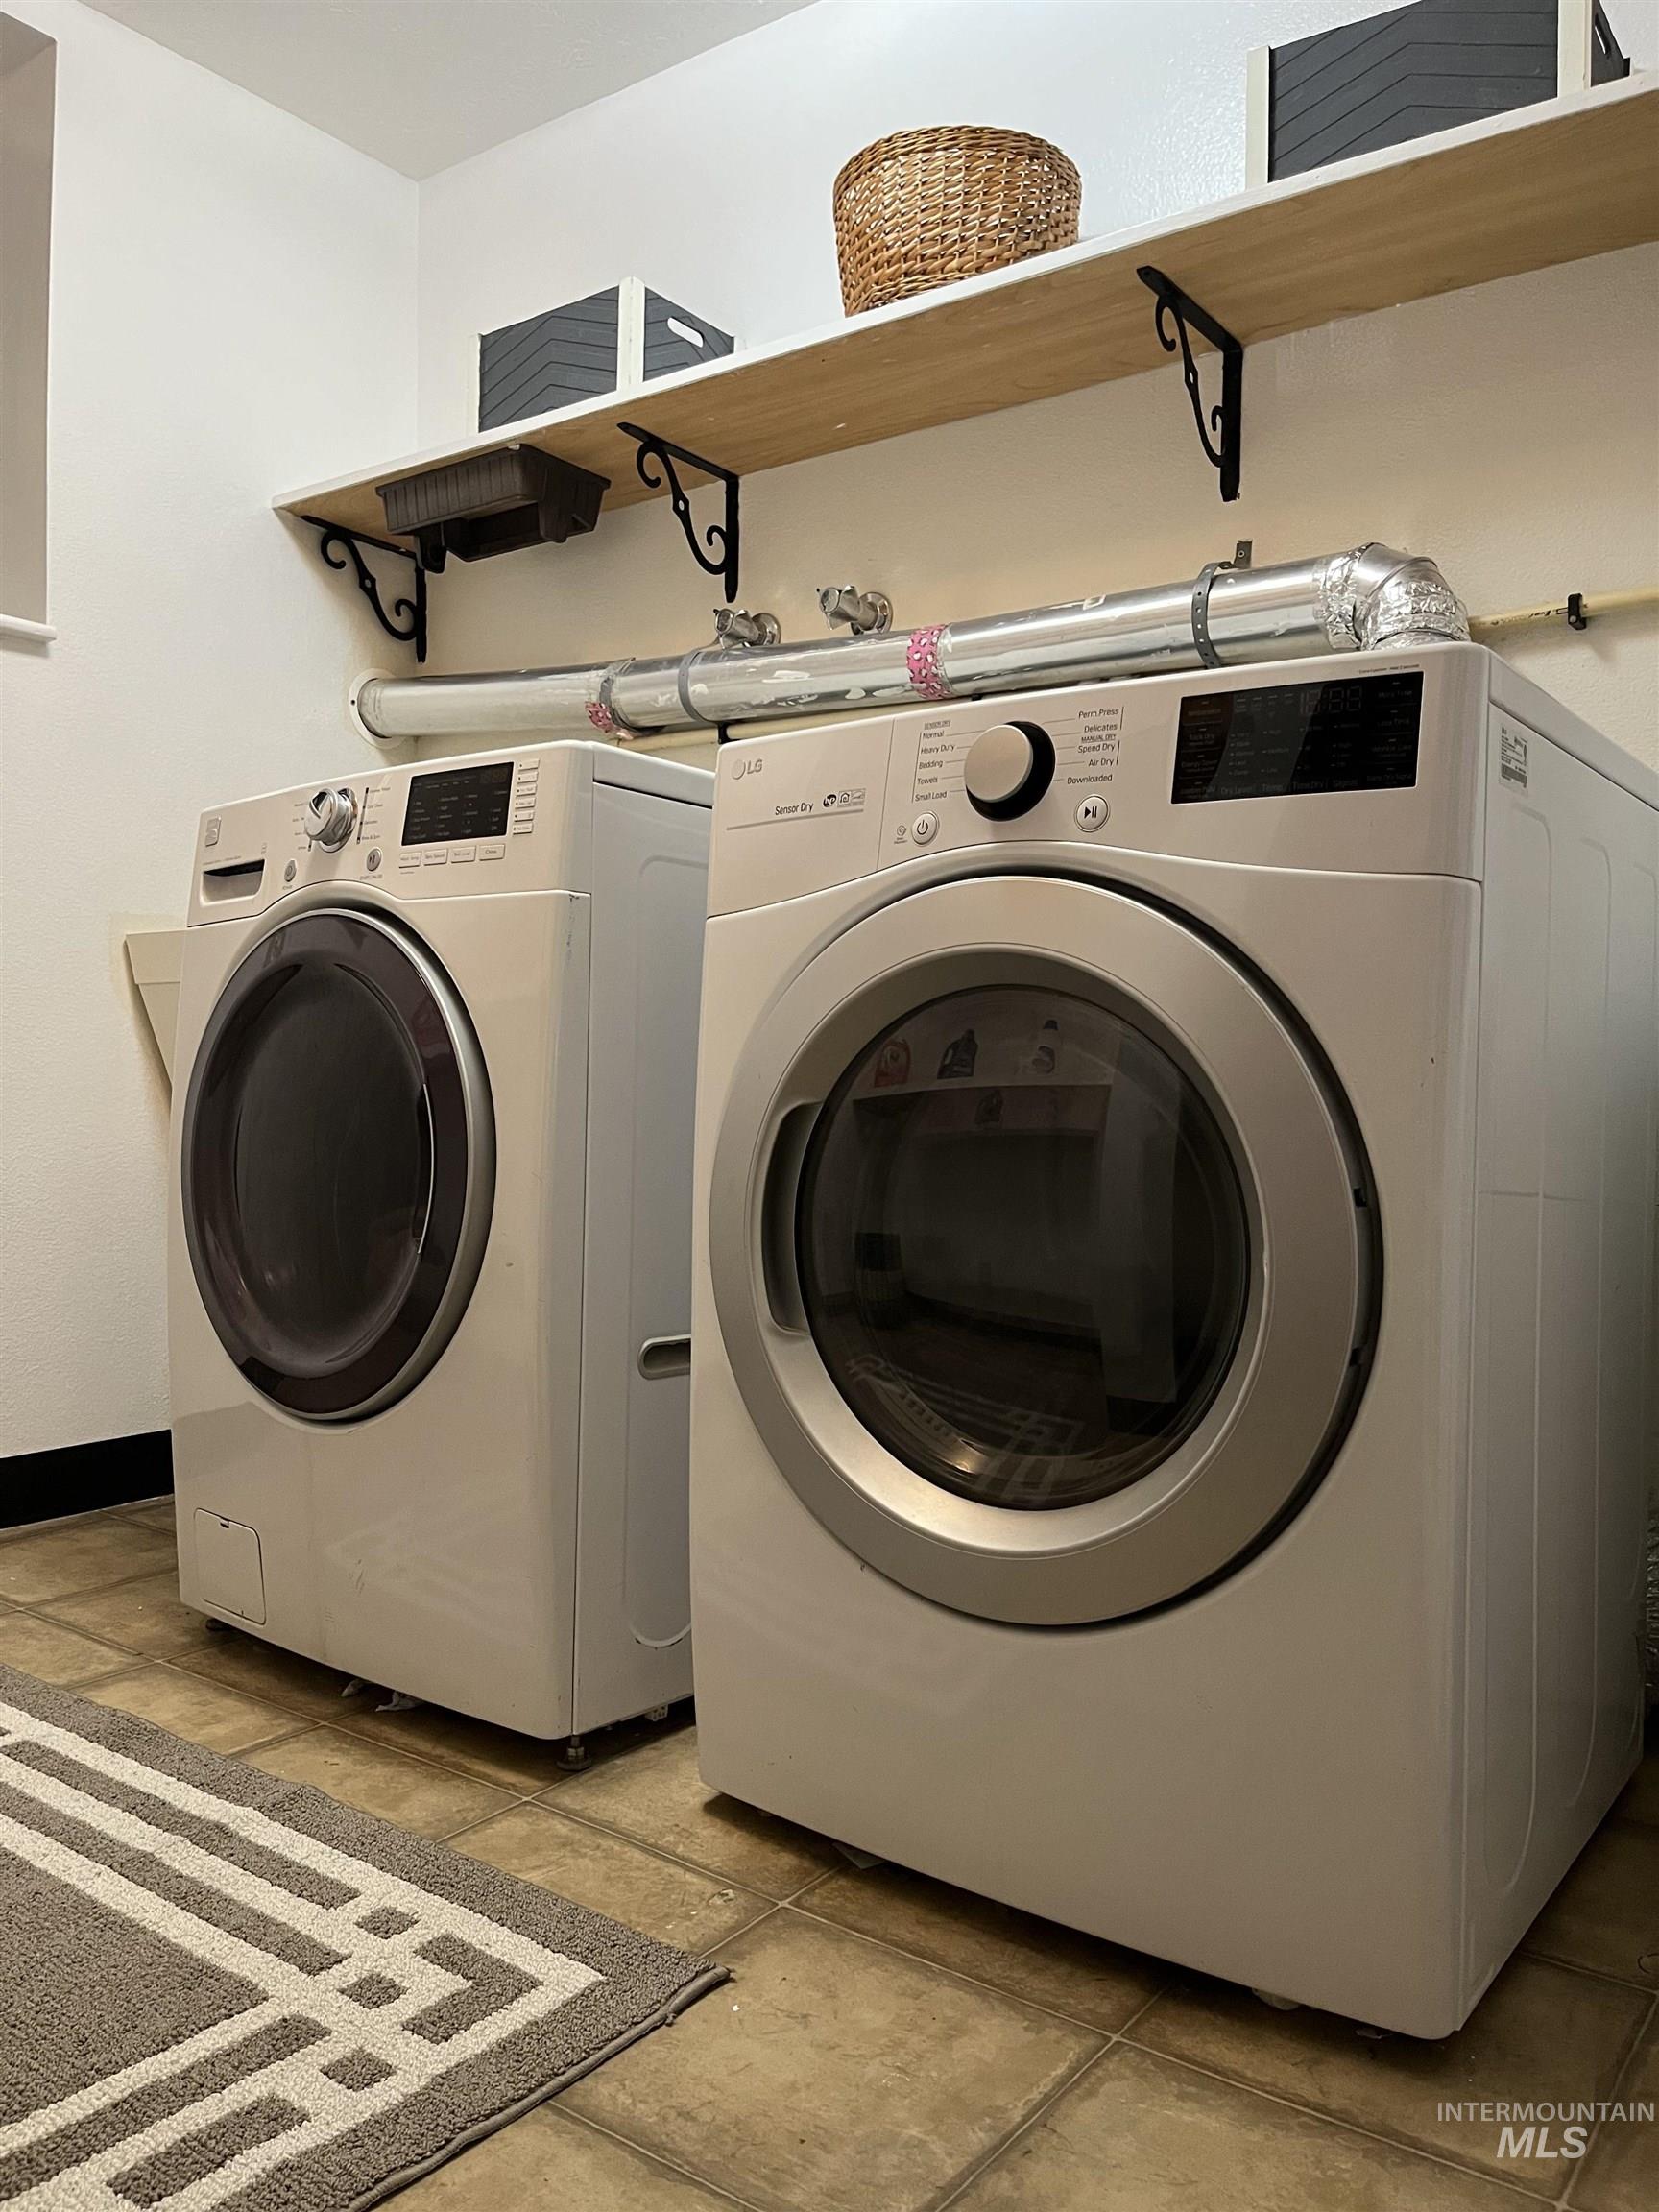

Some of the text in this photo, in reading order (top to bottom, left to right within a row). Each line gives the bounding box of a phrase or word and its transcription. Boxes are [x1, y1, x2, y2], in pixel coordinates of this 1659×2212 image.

[1084, 723, 1118, 733] Delicates
[922, 731, 945, 739] Normal
[921, 743, 955, 755] Heavy Duty
[1077, 742, 1116, 754] Speed Dry
[746, 758, 763, 774] LG
[918, 759, 943, 770] Bedding
[1088, 757, 1115, 767] Air Dry
[917, 776, 938, 785] Towels
[1067, 774, 1113, 785] Downloaded
[914, 790, 948, 802] Small Load
[775, 802, 814, 816] Sensor Dry
